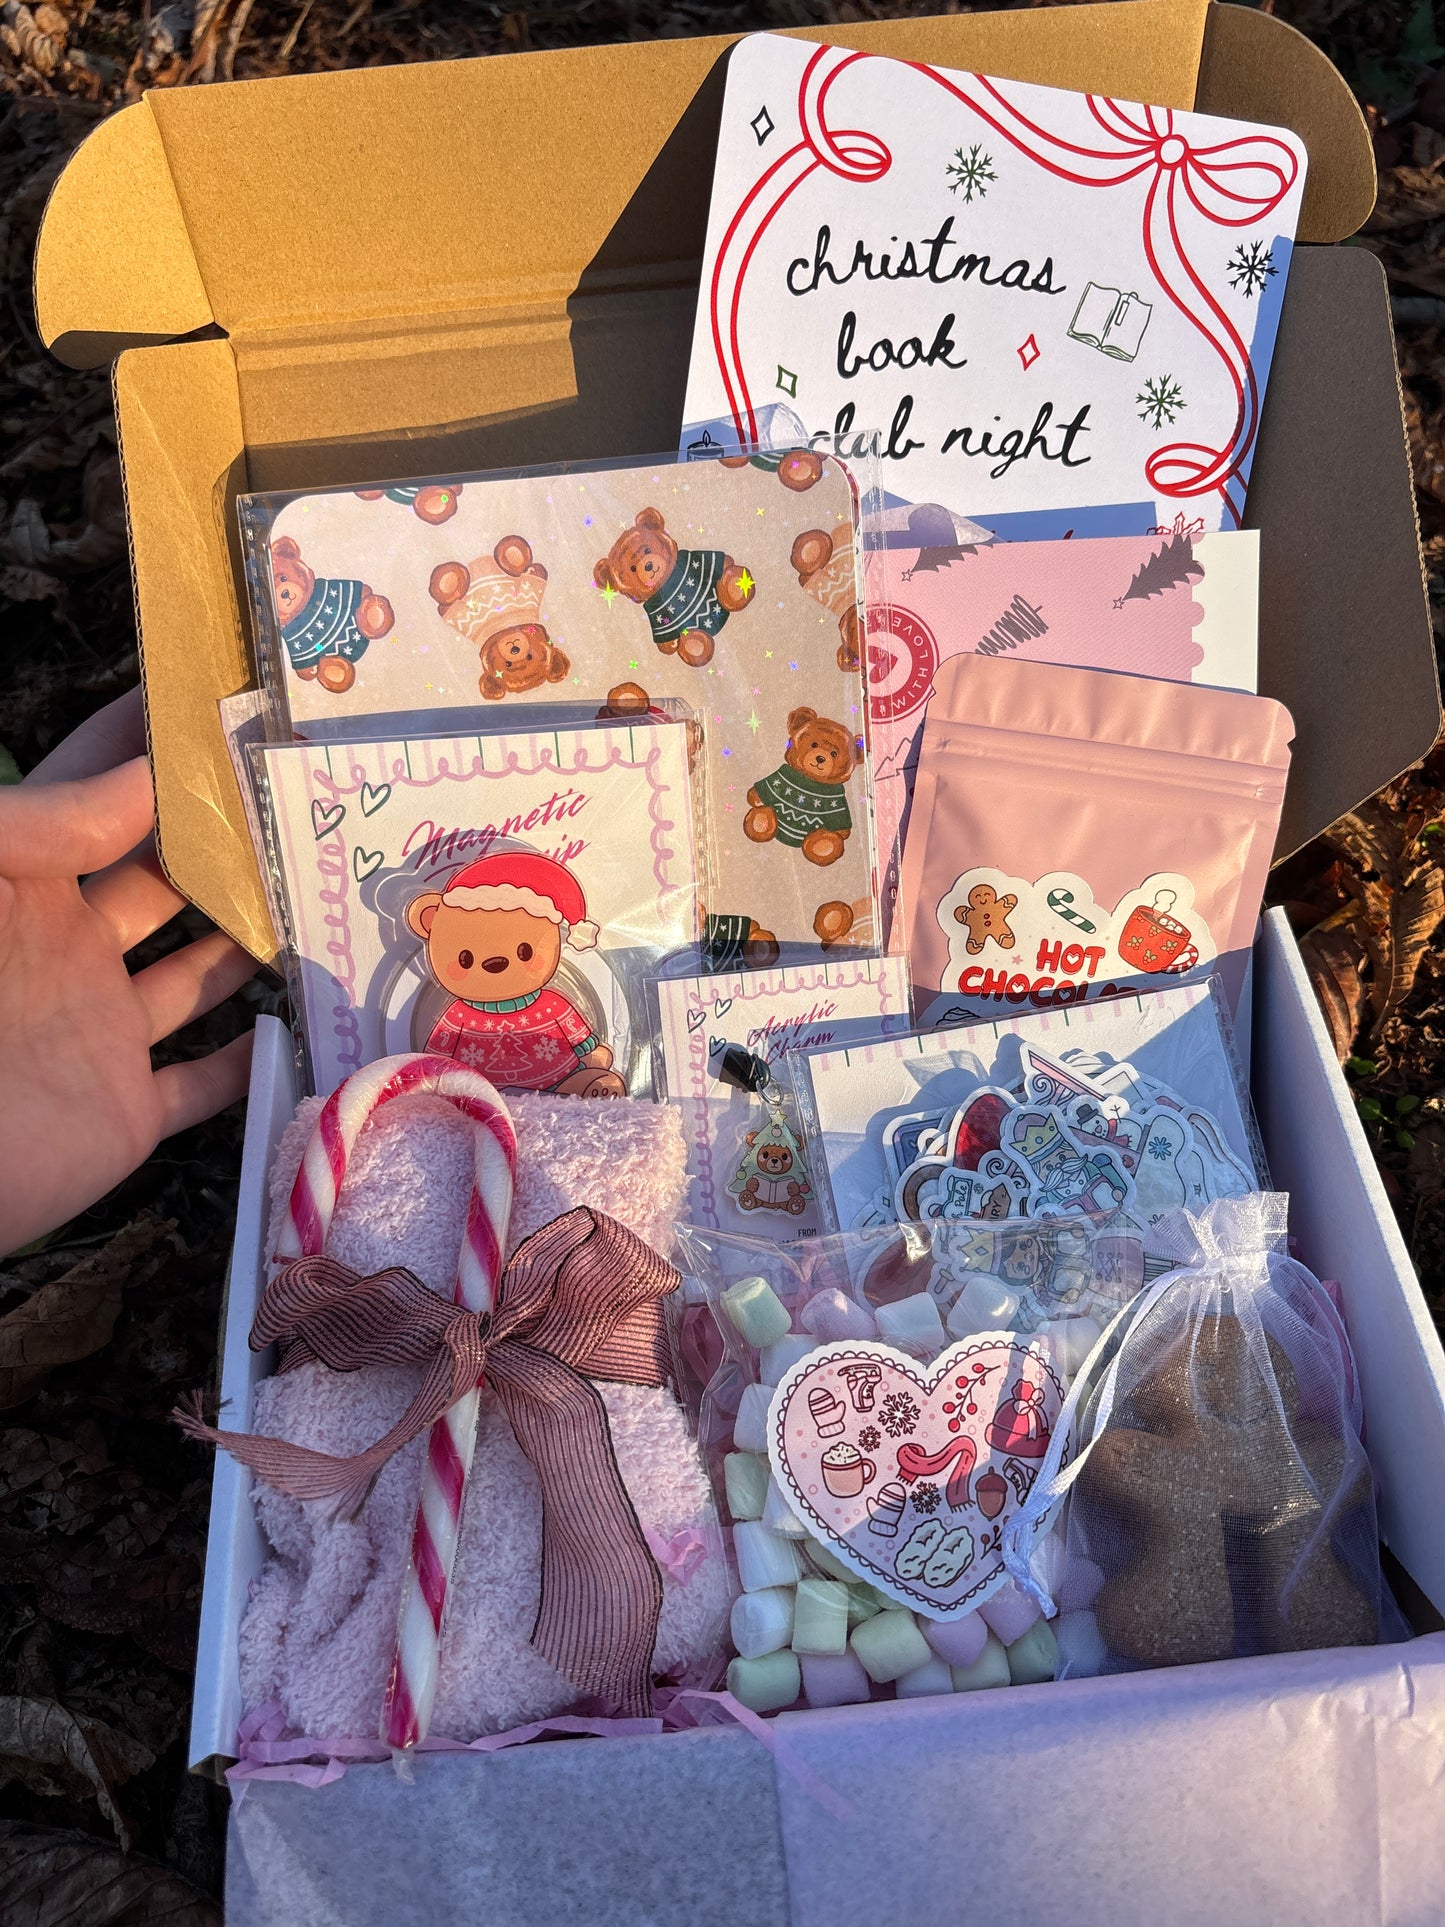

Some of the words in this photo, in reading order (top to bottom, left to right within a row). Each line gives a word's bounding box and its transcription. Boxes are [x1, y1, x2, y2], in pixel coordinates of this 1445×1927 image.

[787, 215, 1067, 296] christmas
[836, 310, 968, 379] book
[808, 394, 926, 461] club
[941, 401, 1091, 479] night
[891, 615, 929, 660] LOVE
[891, 666, 929, 710] WITH
[400, 787, 594, 871] Magnetic
[1036, 938, 1106, 978] HOT
[747, 999, 840, 1047] Acrylic
[765, 1030, 838, 1066] Charm
[797, 1227, 818, 1238] FROM
